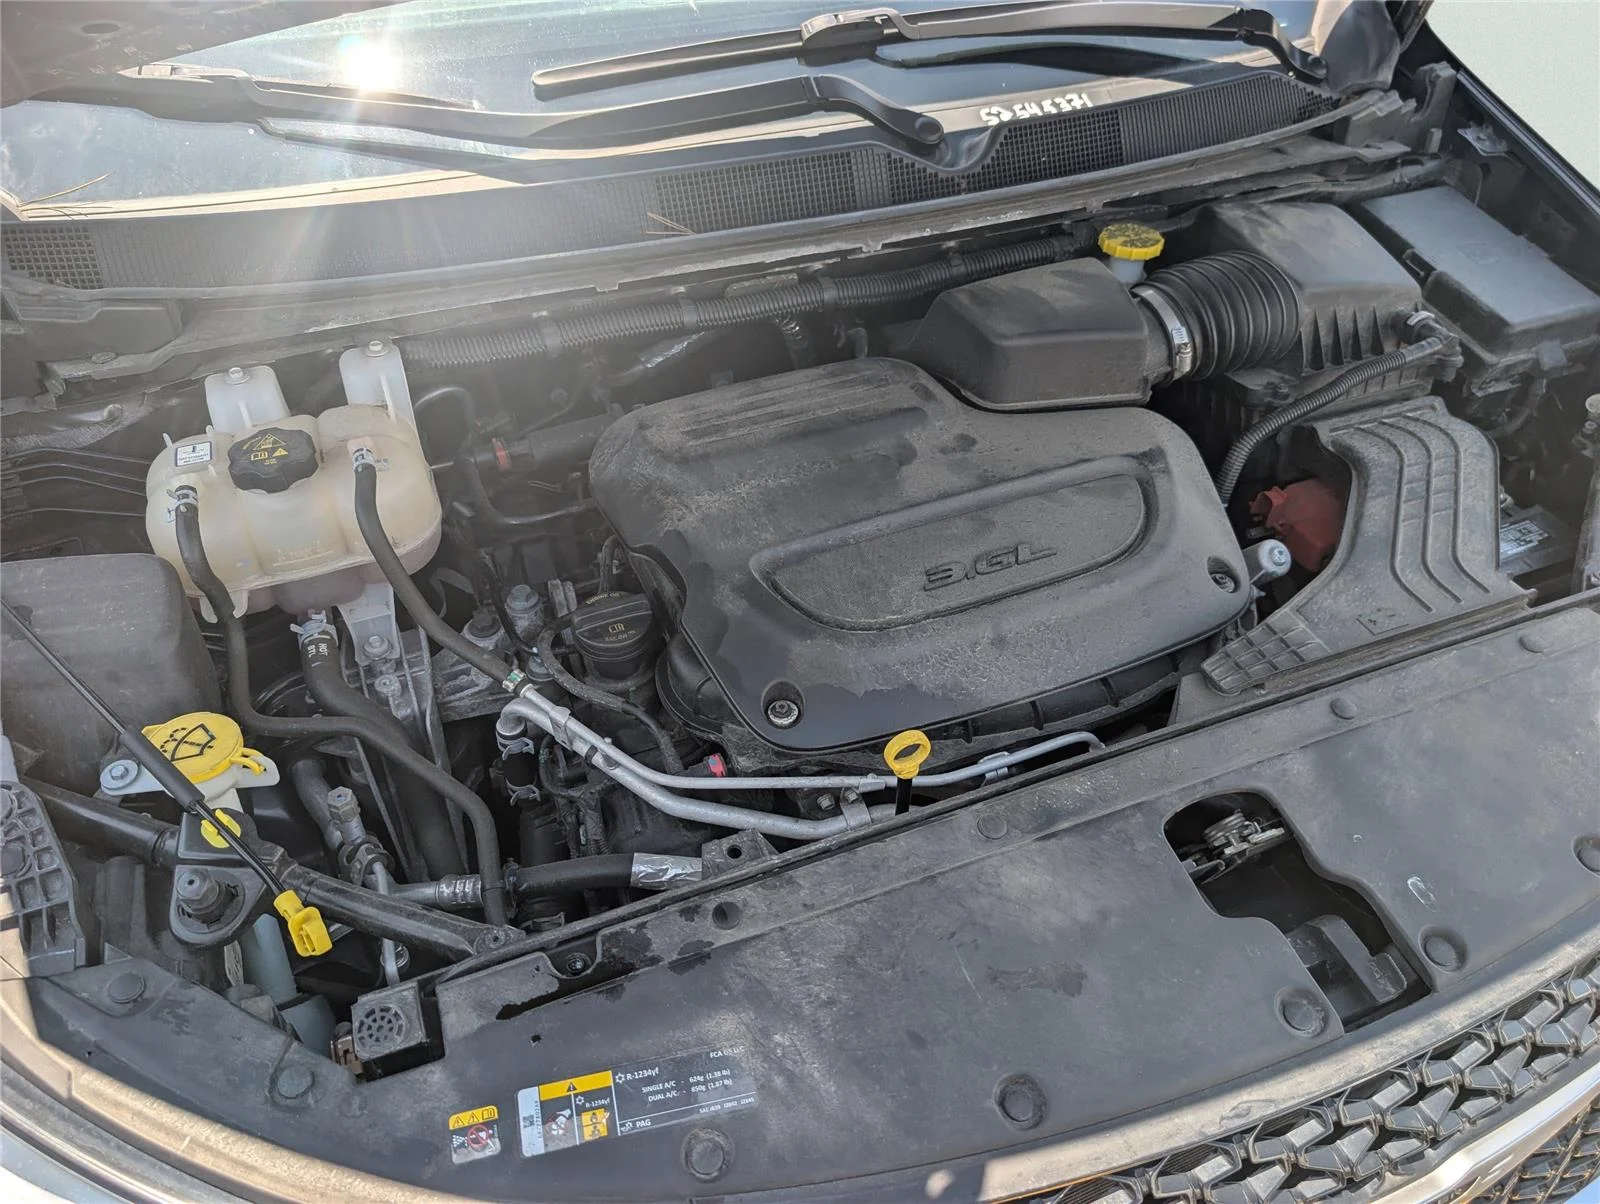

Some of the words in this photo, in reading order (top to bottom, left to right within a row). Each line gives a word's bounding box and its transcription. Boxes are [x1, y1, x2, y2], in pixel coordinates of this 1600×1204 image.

[318, 642, 328, 656] HOT
[710, 1050, 723, 1058] FCA
[626, 1067, 659, 1080] R-1234yf
[641, 1083, 663, 1094] SINGLE
[664, 1080, 677, 1090] A/C
[689, 1074, 704, 1084] 624g
[648, 1092, 665, 1102] DUAL
[585, 1098, 611, 1108] R-1234yf
[636, 1119, 651, 1128] PAG
